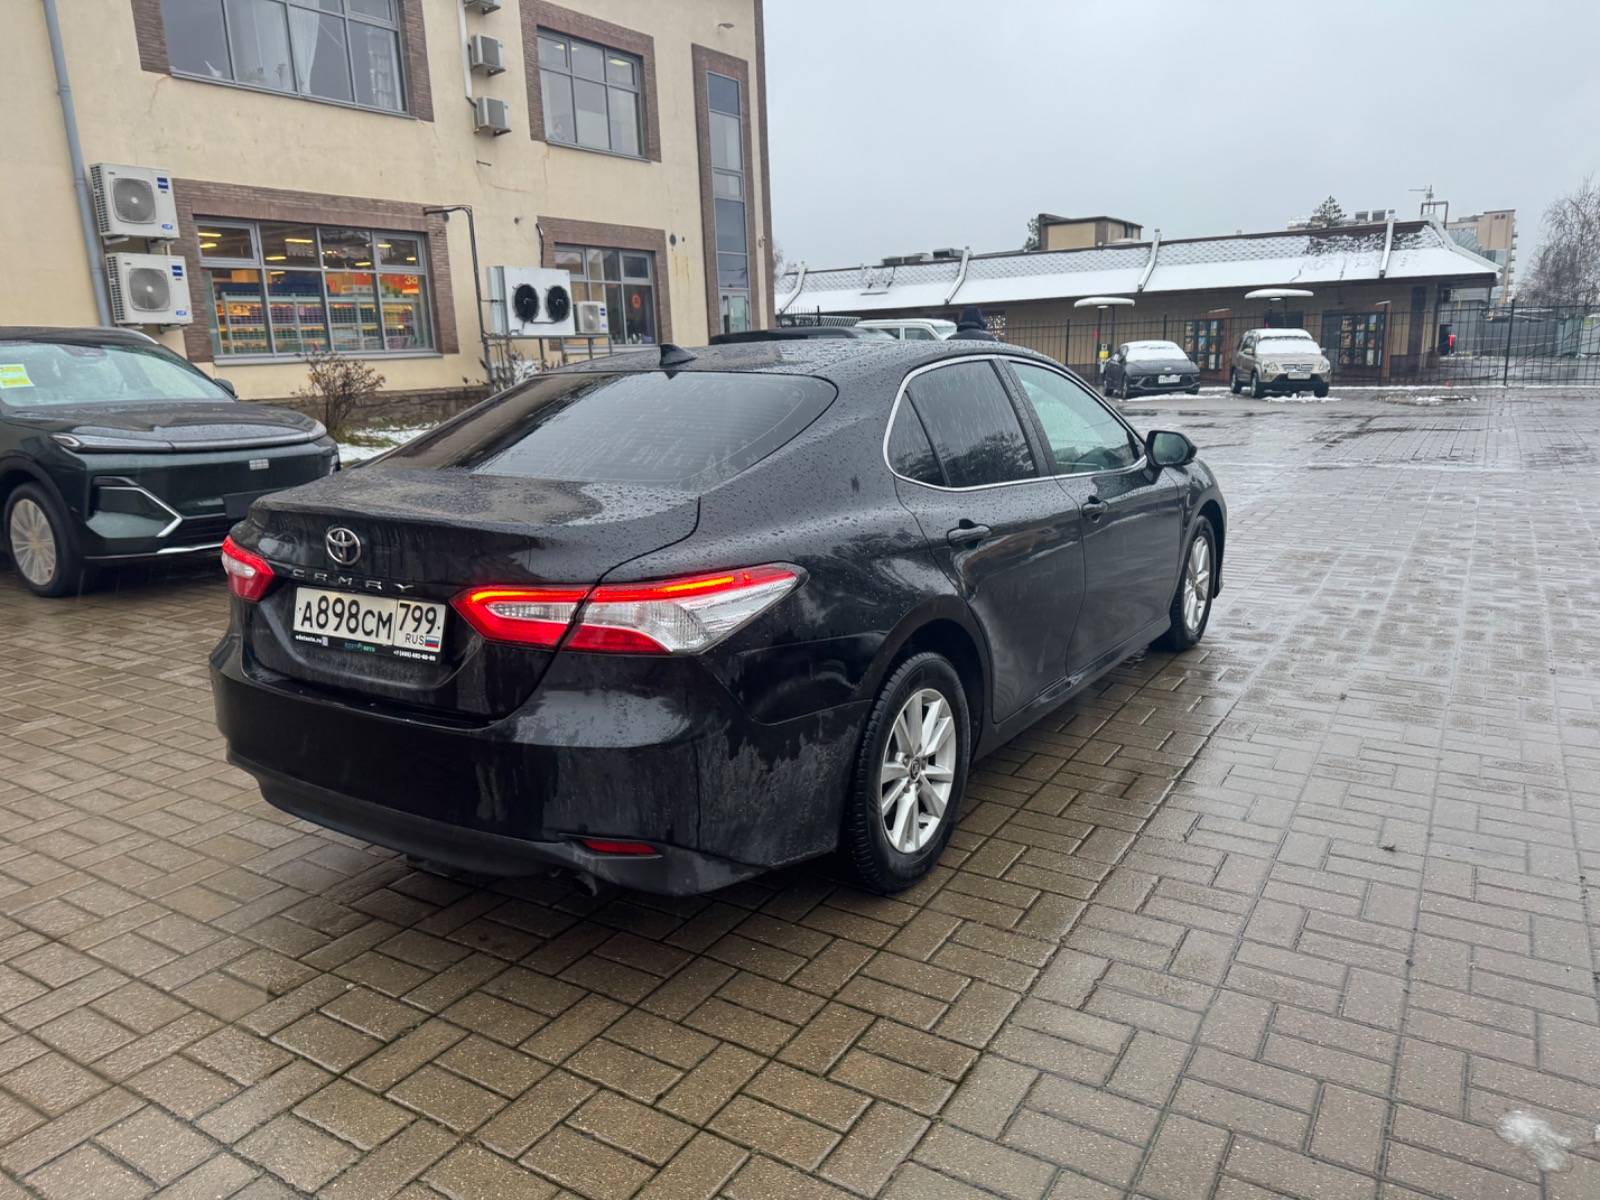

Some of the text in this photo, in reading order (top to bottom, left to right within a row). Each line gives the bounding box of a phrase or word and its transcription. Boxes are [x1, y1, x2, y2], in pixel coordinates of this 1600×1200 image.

[293, 569, 414, 592] CAMRY
[301, 595, 437, 640] А898СМ 799
[405, 633, 424, 646] RUS
